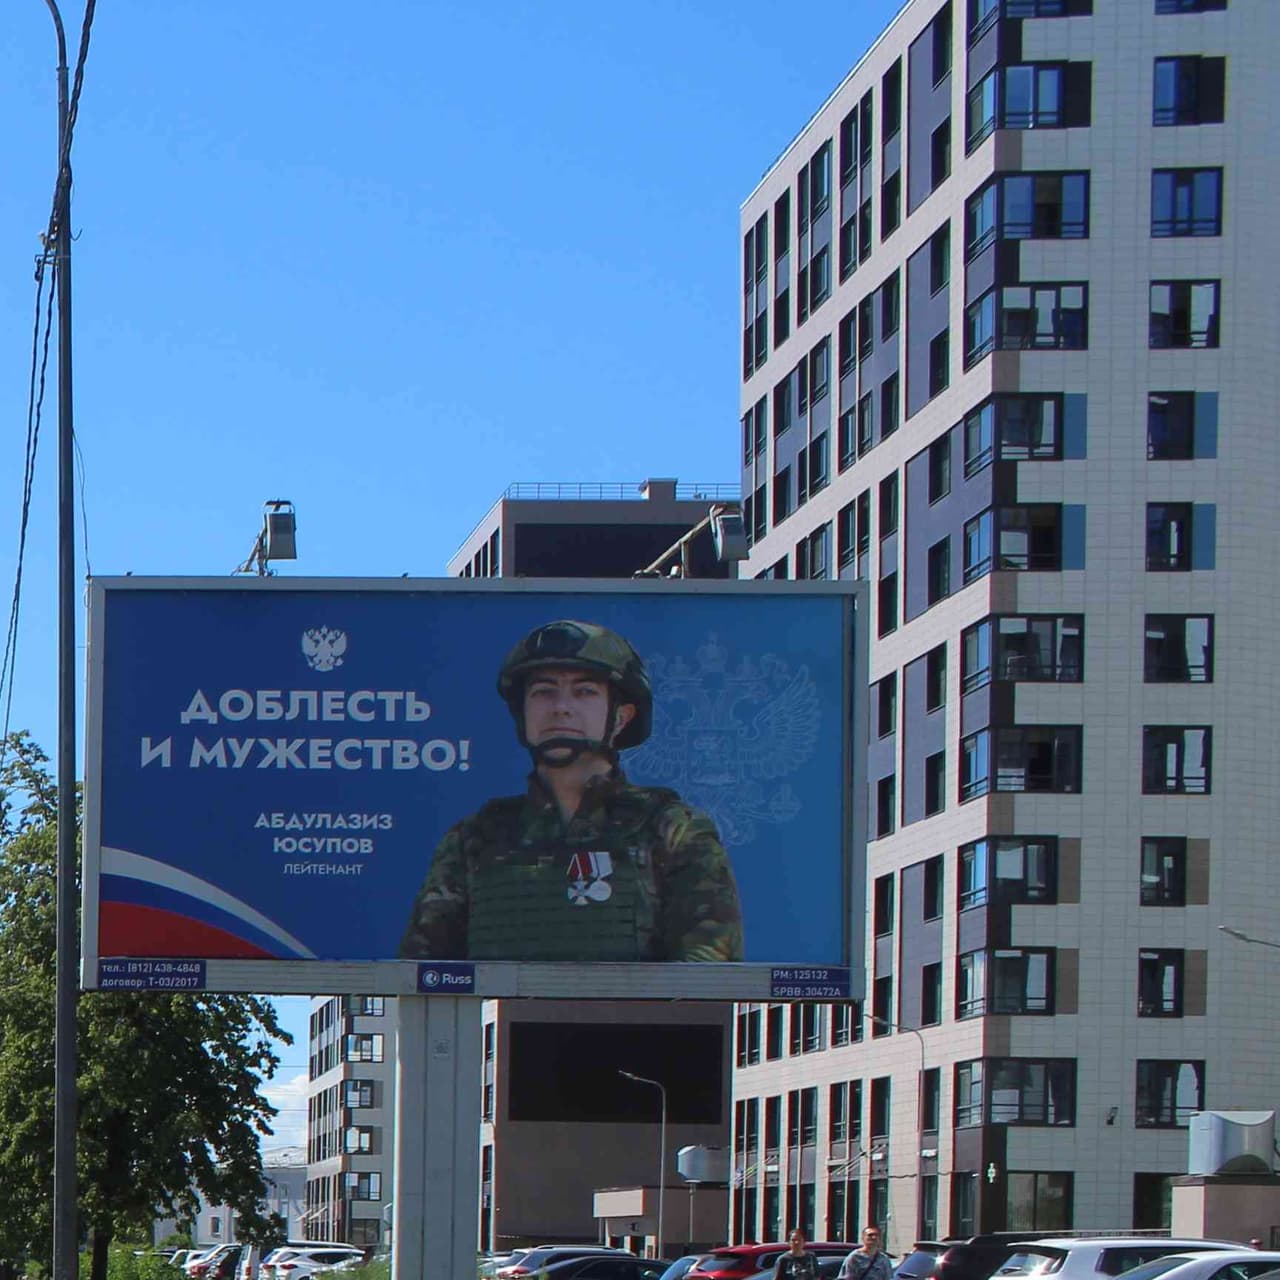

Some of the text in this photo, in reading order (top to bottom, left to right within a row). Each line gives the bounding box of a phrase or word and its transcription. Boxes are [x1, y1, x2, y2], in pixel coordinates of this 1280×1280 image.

[180, 689, 431, 724] ДОБЛЕСТЬ
[141, 737, 471, 772] И МУЖЕСТВО!
[254, 812, 393, 831] АБДУЛАЗИЗ
[272, 837, 374, 854] ЮСУПОВ
[283, 861, 363, 876] ЛЕЙТЕНАНТ
[154, 963, 201, 973] 438-4848
[442, 973, 473, 985] Russ
